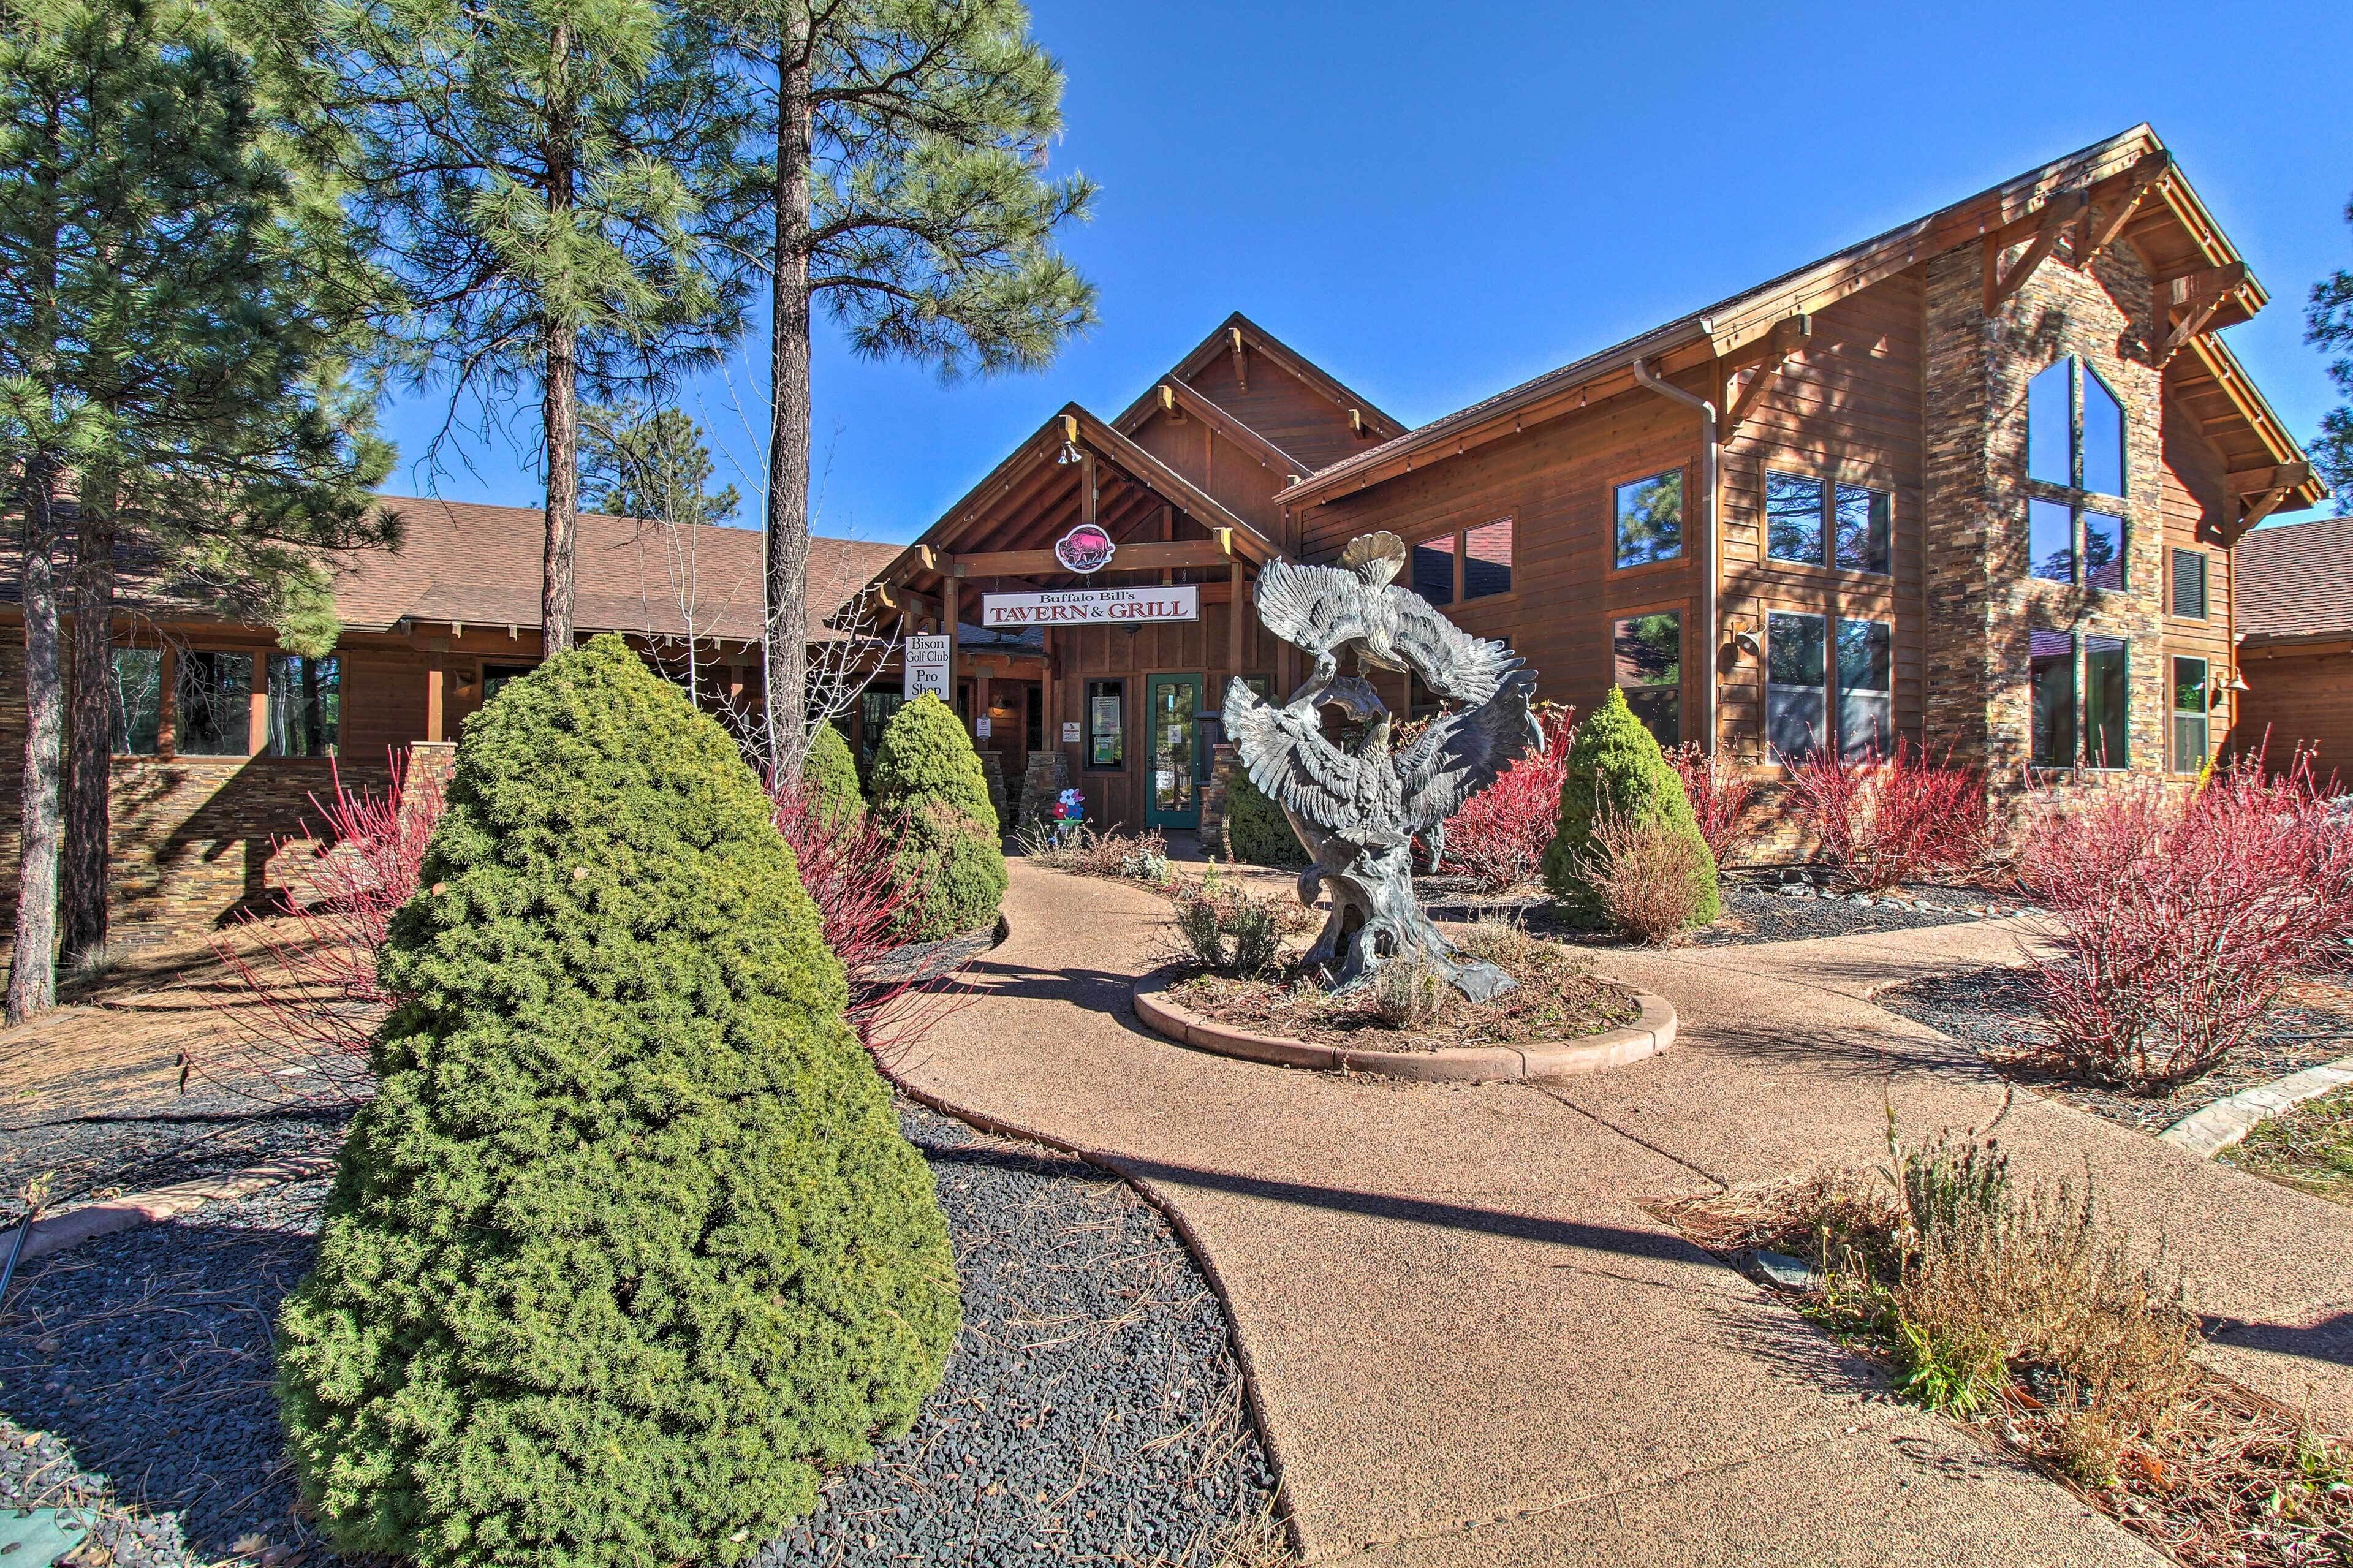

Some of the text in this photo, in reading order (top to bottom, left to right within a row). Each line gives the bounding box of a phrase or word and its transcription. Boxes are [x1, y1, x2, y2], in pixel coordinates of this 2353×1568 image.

[1040, 591, 1135, 603] Buffalo Bill's
[990, 601, 1188, 623] TAVERN & GRILL
[911, 637, 944, 649] Bison
[906, 651, 948, 662] Golf Club
[917, 670, 938, 681] Pro
